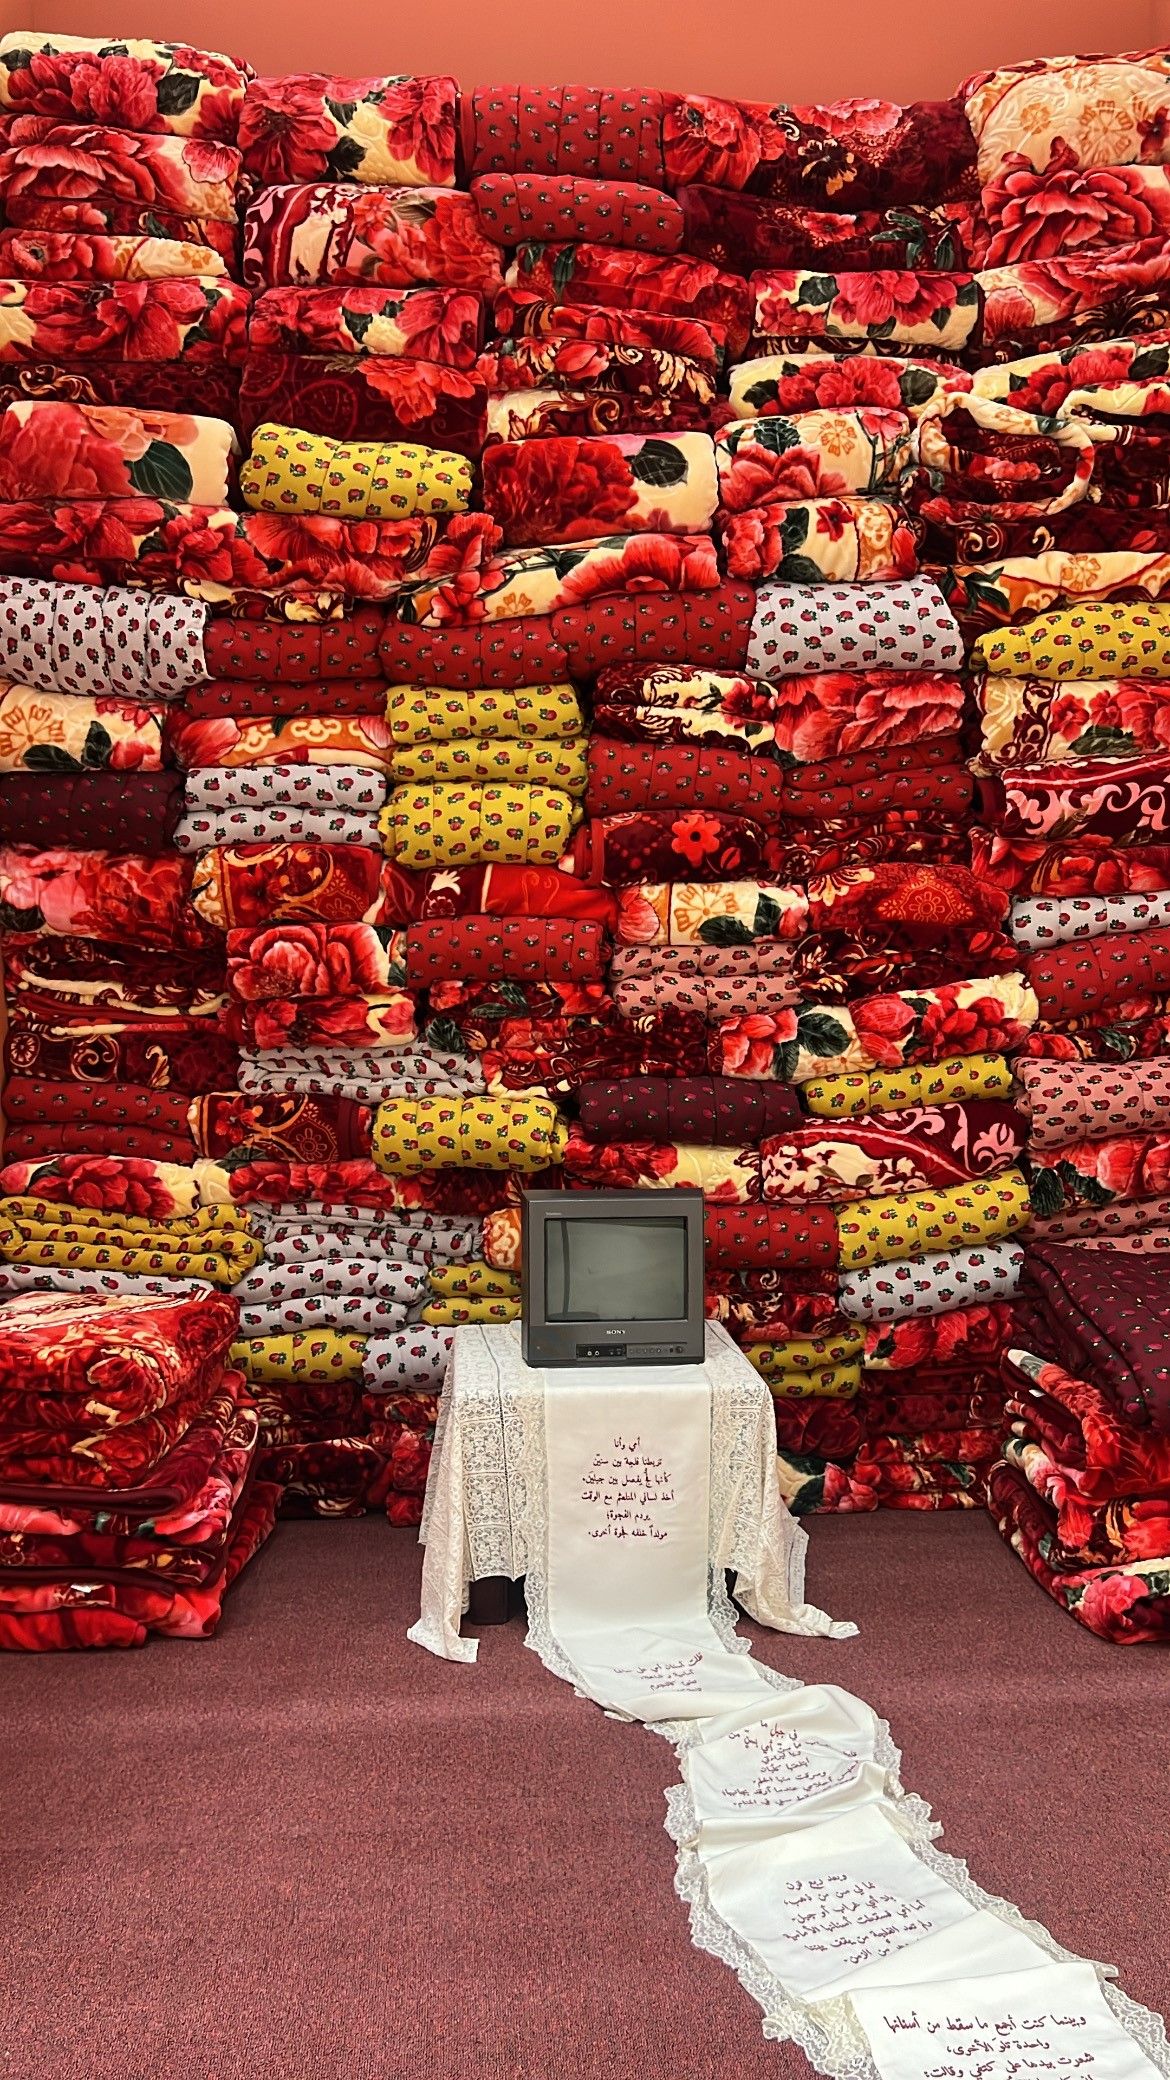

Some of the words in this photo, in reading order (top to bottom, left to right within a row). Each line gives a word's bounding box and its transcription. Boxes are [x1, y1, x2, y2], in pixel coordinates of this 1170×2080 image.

[613, 1436, 626, 1450] وأنا
[629, 1436, 640, 1452] أمي
[612, 1459, 622, 1468] بين
[624, 1457, 639, 1468] فلجة
[642, 1457, 663, 1467] تربطنا
[608, 1476, 618, 1485] بين
[621, 1475, 643, 1487] يفصل
[655, 1471, 672, 1485] كأنها
[581, 1490, 601, 1503] الوقت
[603, 1495, 613, 1506] مع
[616, 1492, 637, 1507] المتلعثم
[639, 1492, 658, 1506] لساني
[661, 1489, 675, 1501] أخذ
[634, 1512, 651, 1524] يردم
[631, 1528, 648, 1538] خلفه
[728, 1732, 741, 1740] من
[769, 1722, 786, 1739] جبل
[785, 1880, 803, 1891] قرن
[808, 1878, 825, 1890] ربع
[818, 1893, 830, 1902] من
[820, 1904, 830, 1918] أو
[857, 1910, 892, 1925] فسقطت
[857, 1935, 869, 1945] من
[882, 2010, 921, 2034] أسنانها
[926, 2021, 941, 2034] من
[946, 2016, 974, 2031] سقط
[974, 2015, 989, 2029] ما
[994, 2014, 1017, 2036] أجمع
[1021, 2015, 1047, 2030] كنت
[1050, 2014, 1087, 2028] وبينما
[946, 2038, 994, 2057] الأخرى،
[1012, 2038, 1050, 2050] واحدة
[1021, 2058, 1057, 2070] بيدها
[1057, 2052, 1095, 2068] شعرت
[923, 2065, 964, 2078] وقالت:
[969, 2060, 996, 2078] كتفي
[1005, 2060, 1022, 2074] على
